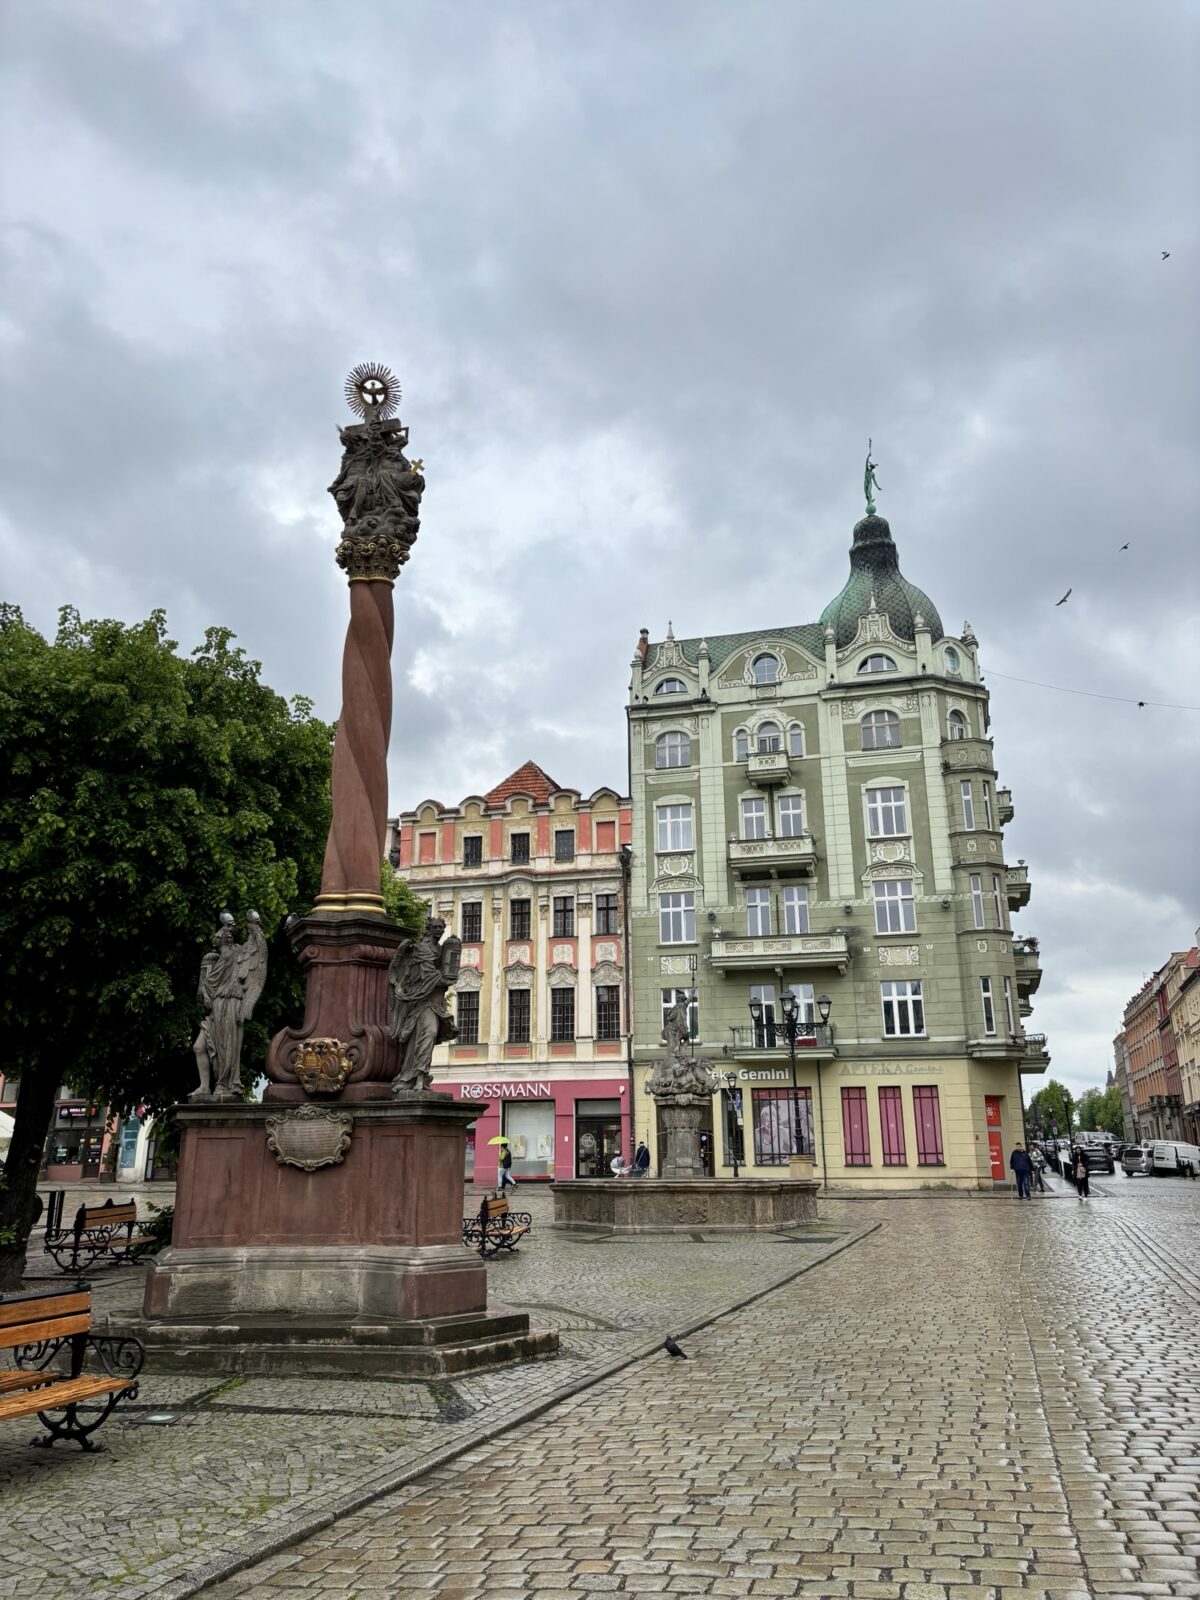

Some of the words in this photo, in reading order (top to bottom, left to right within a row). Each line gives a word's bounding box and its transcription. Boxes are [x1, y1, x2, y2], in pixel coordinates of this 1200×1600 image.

[738, 1068, 789, 1080] Gemini
[840, 1063, 903, 1075] APTEKA
[461, 1083, 551, 1098] ROSSMANN
